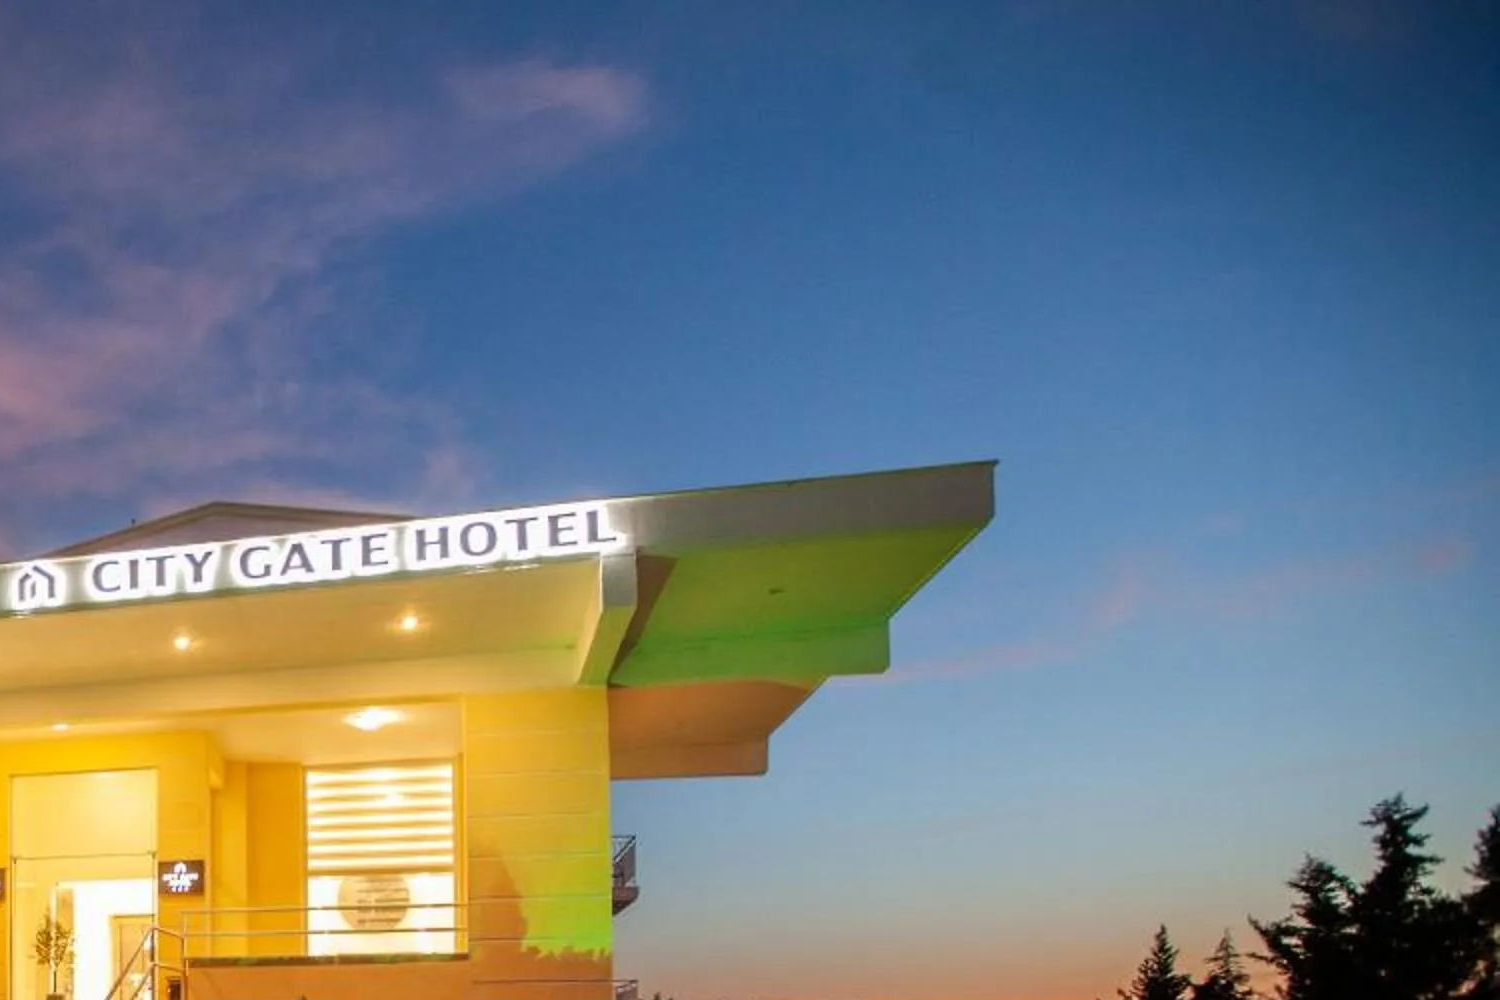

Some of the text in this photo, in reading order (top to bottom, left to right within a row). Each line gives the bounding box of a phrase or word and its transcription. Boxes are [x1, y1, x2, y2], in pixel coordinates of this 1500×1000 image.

[92, 509, 617, 592] CITY GATE HOTEL
